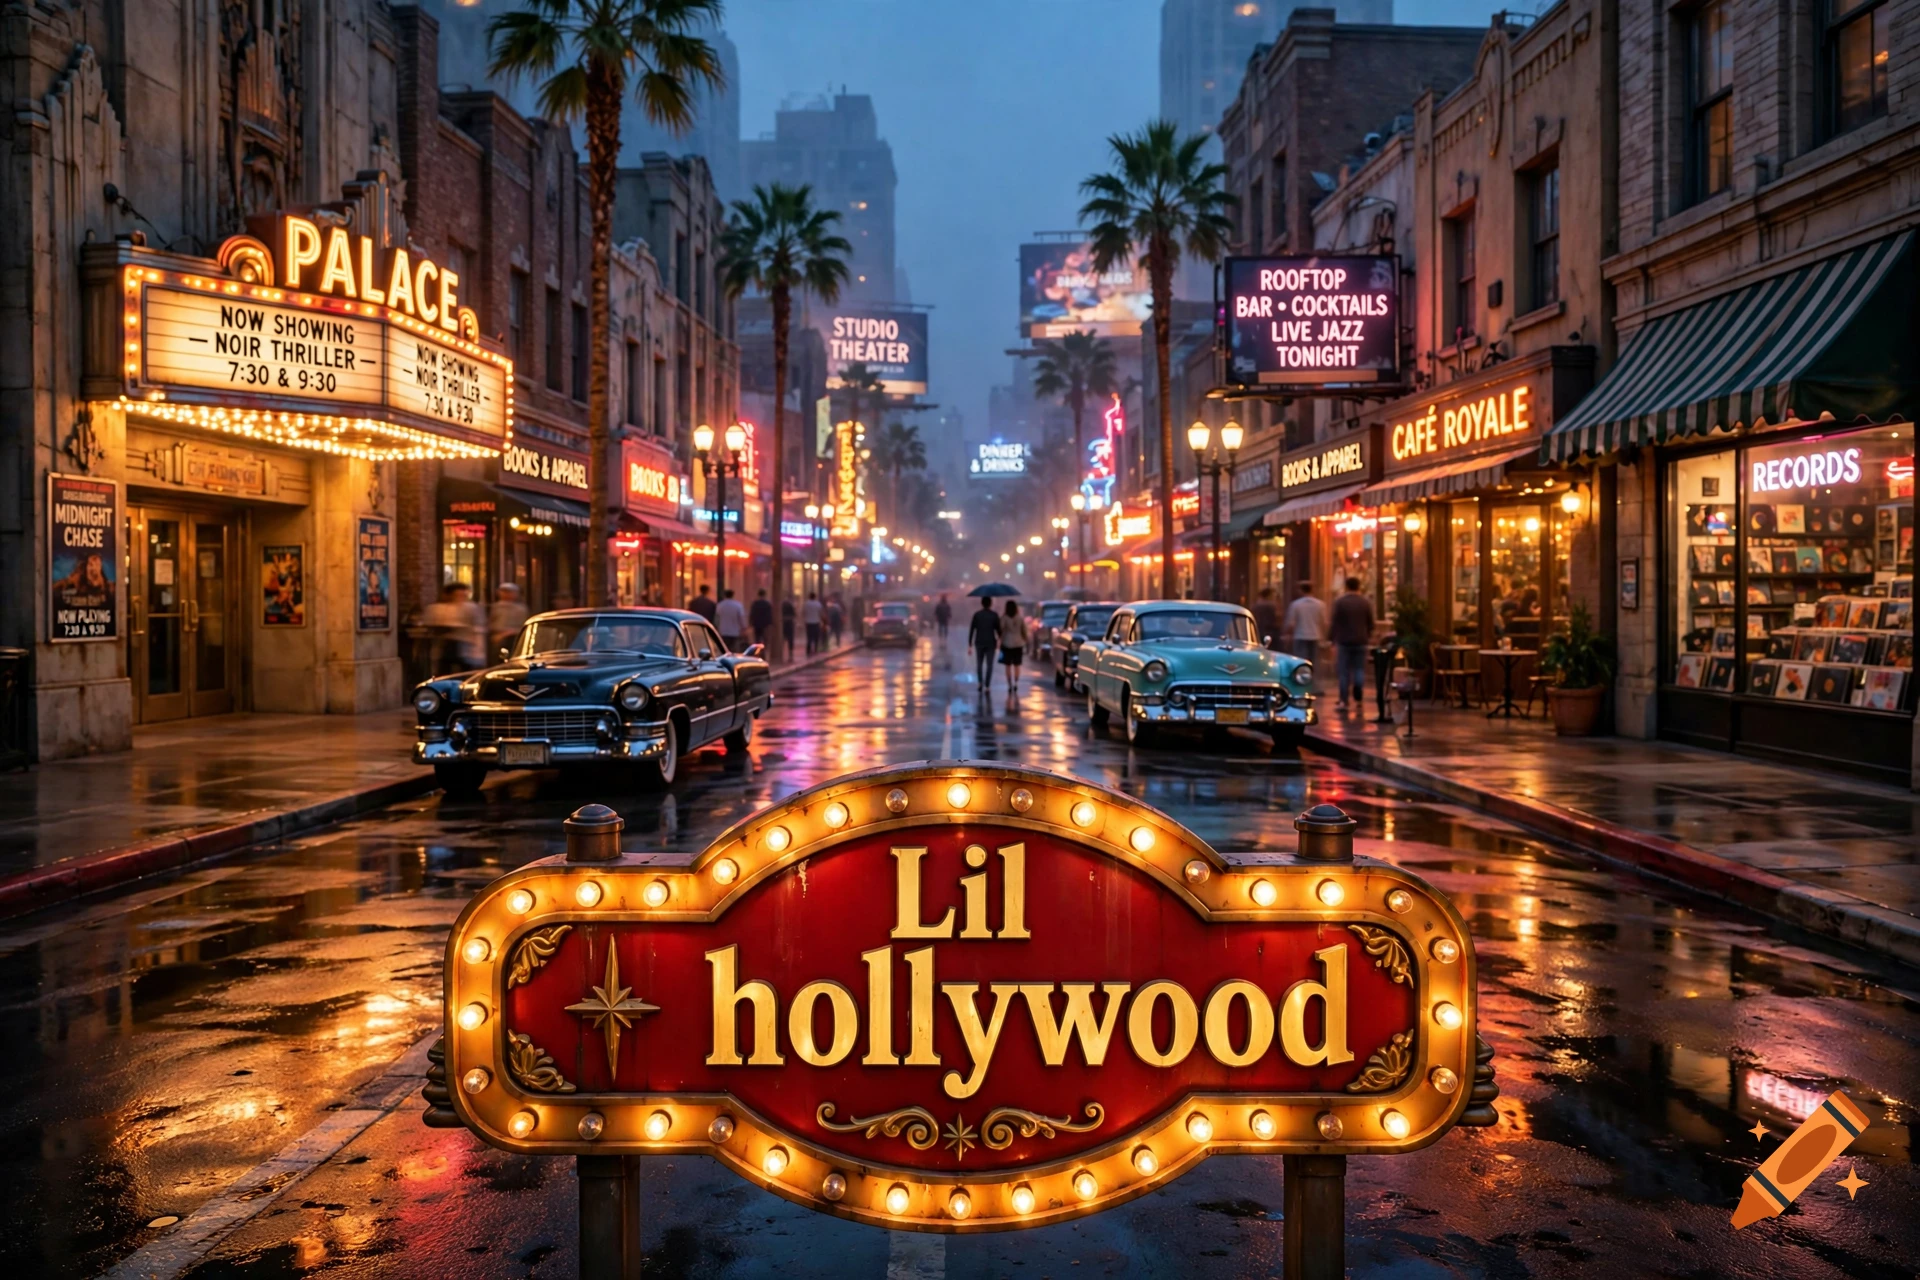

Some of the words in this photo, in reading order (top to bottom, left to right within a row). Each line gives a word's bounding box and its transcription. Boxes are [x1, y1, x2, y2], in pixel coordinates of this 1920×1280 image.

[285, 215, 459, 332] PALACE
[1260, 268, 1347, 291] ROOFTOP
[1236, 295, 1273, 318] BAR
[1291, 294, 1389, 317] COCKTAILS
[220, 305, 264, 332] NOW
[274, 314, 355, 345] SHOWING
[833, 316, 899, 341] STUDIO
[1271, 320, 1313, 342] LIVE
[1317, 319, 1365, 342] JAZZ
[215, 331, 261, 358] NOIR
[271, 339, 356, 371] THRILLER
[416, 343, 438, 368] NOW
[830, 339, 910, 364] THEATER
[1276, 345, 1360, 368] TONIGHT
[228, 361, 269, 386] 7:30
[278, 367, 289, 388] &
[298, 369, 336, 394] 9:30
[416, 365, 438, 391] NOIR
[1392, 404, 1438, 460] CAFÉ
[1443, 385, 1529, 449] ROYALE
[503, 445, 540, 478] BOOKS
[551, 457, 588, 490] APPAREL
[1753, 447, 1862, 493] RECORDS
[55, 502, 113, 527] MIDNIGHT
[63, 526, 104, 548] CHASE
[890, 841, 1031, 940] Lil
[704, 943, 1355, 1100] hollywood
